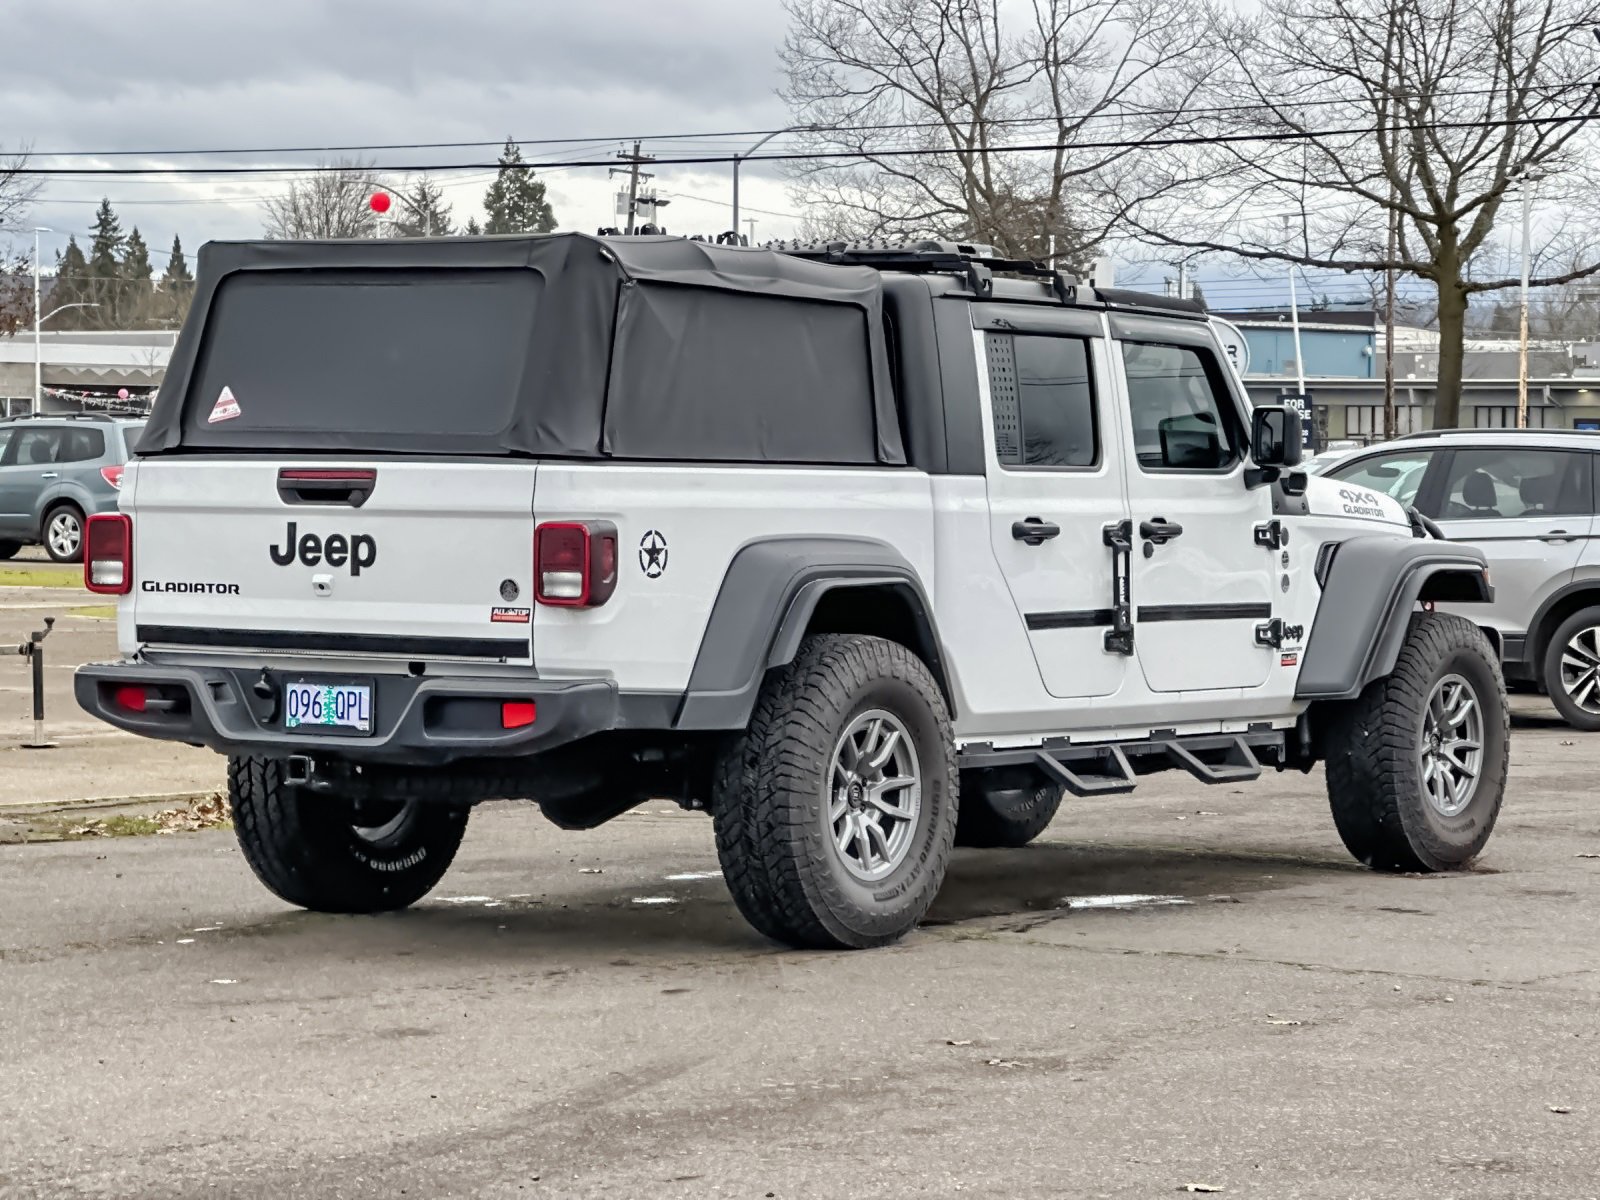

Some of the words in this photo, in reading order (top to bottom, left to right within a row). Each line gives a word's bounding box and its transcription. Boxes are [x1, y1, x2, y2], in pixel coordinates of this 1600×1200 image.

[1284, 399, 1305, 409] FOR
[1343, 503, 1385, 518] GLADIATOR
[269, 521, 377, 576] Jeep
[141, 580, 241, 596] GLADIATOR
[1280, 622, 1304, 642] Jeep
[289, 689, 322, 719] 096
[335, 690, 369, 721] QPL
